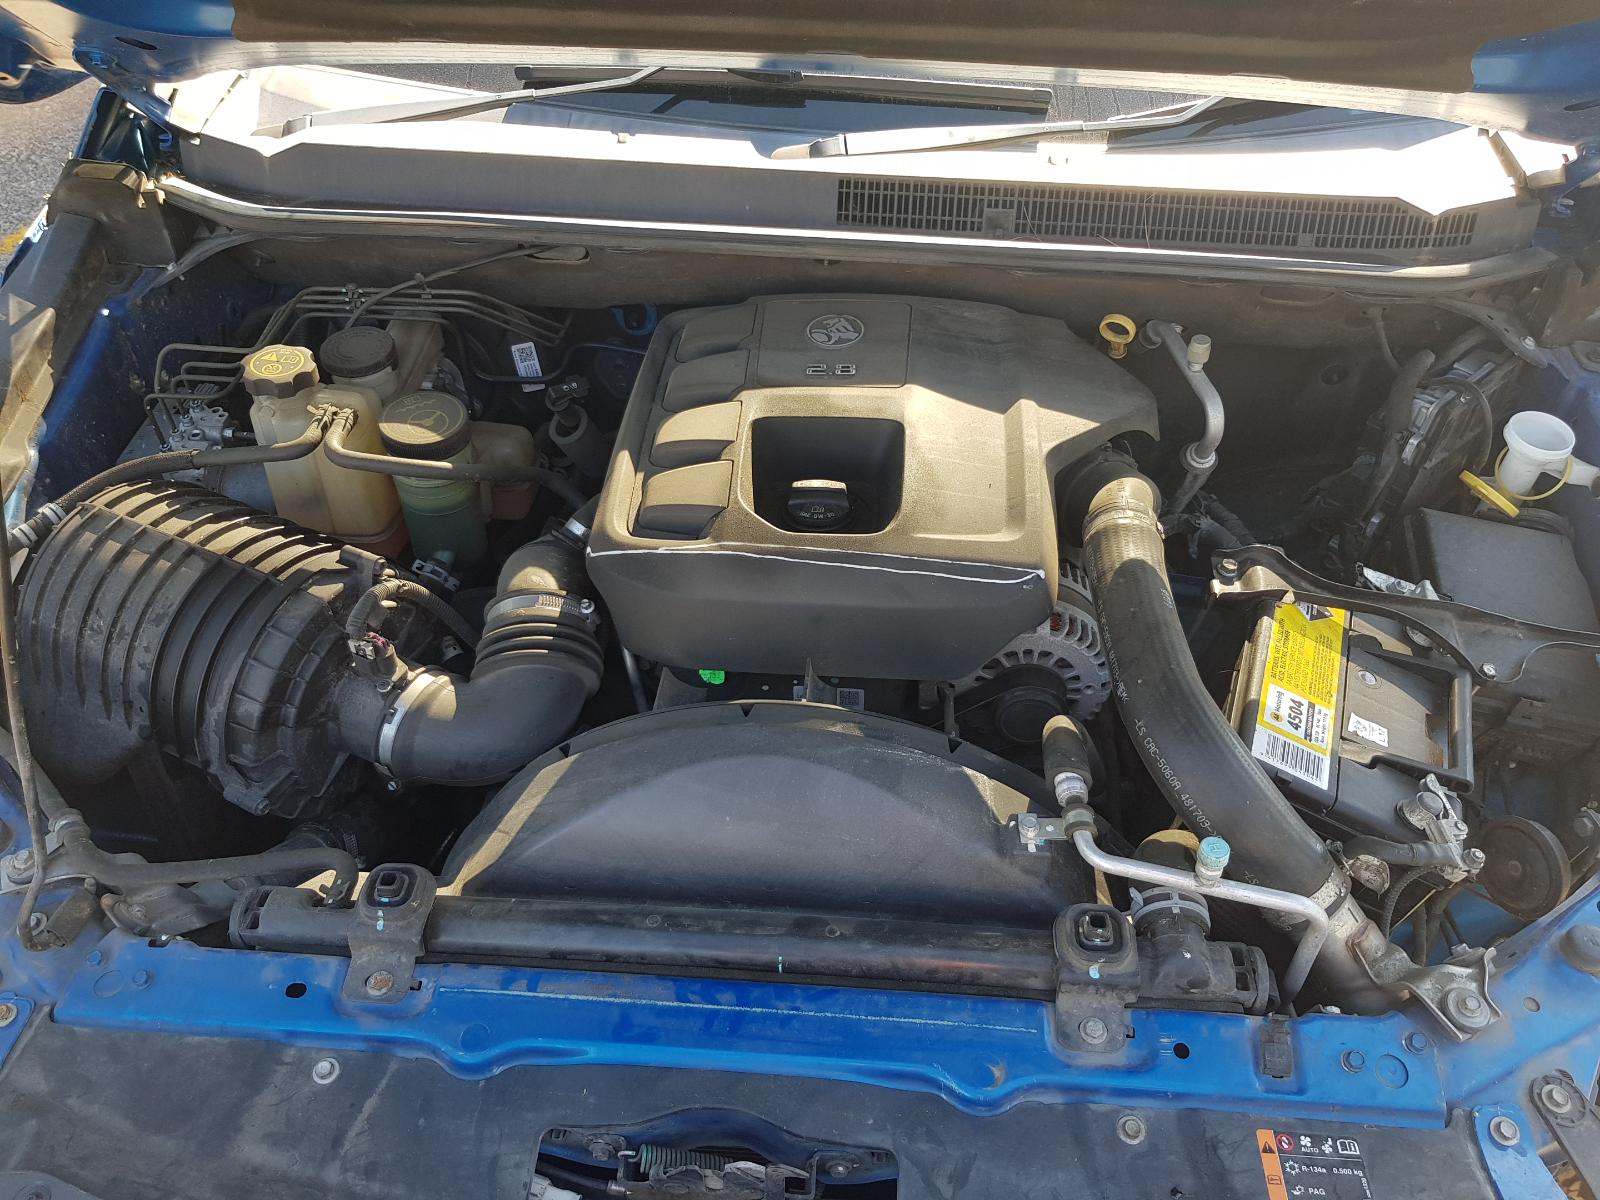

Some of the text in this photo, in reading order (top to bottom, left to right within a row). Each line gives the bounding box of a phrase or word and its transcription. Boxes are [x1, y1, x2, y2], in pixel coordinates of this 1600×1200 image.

[807, 364, 856, 375] 2.8
[1274, 690, 1284, 712] Motoring
[1287, 698, 1303, 731] 4504
